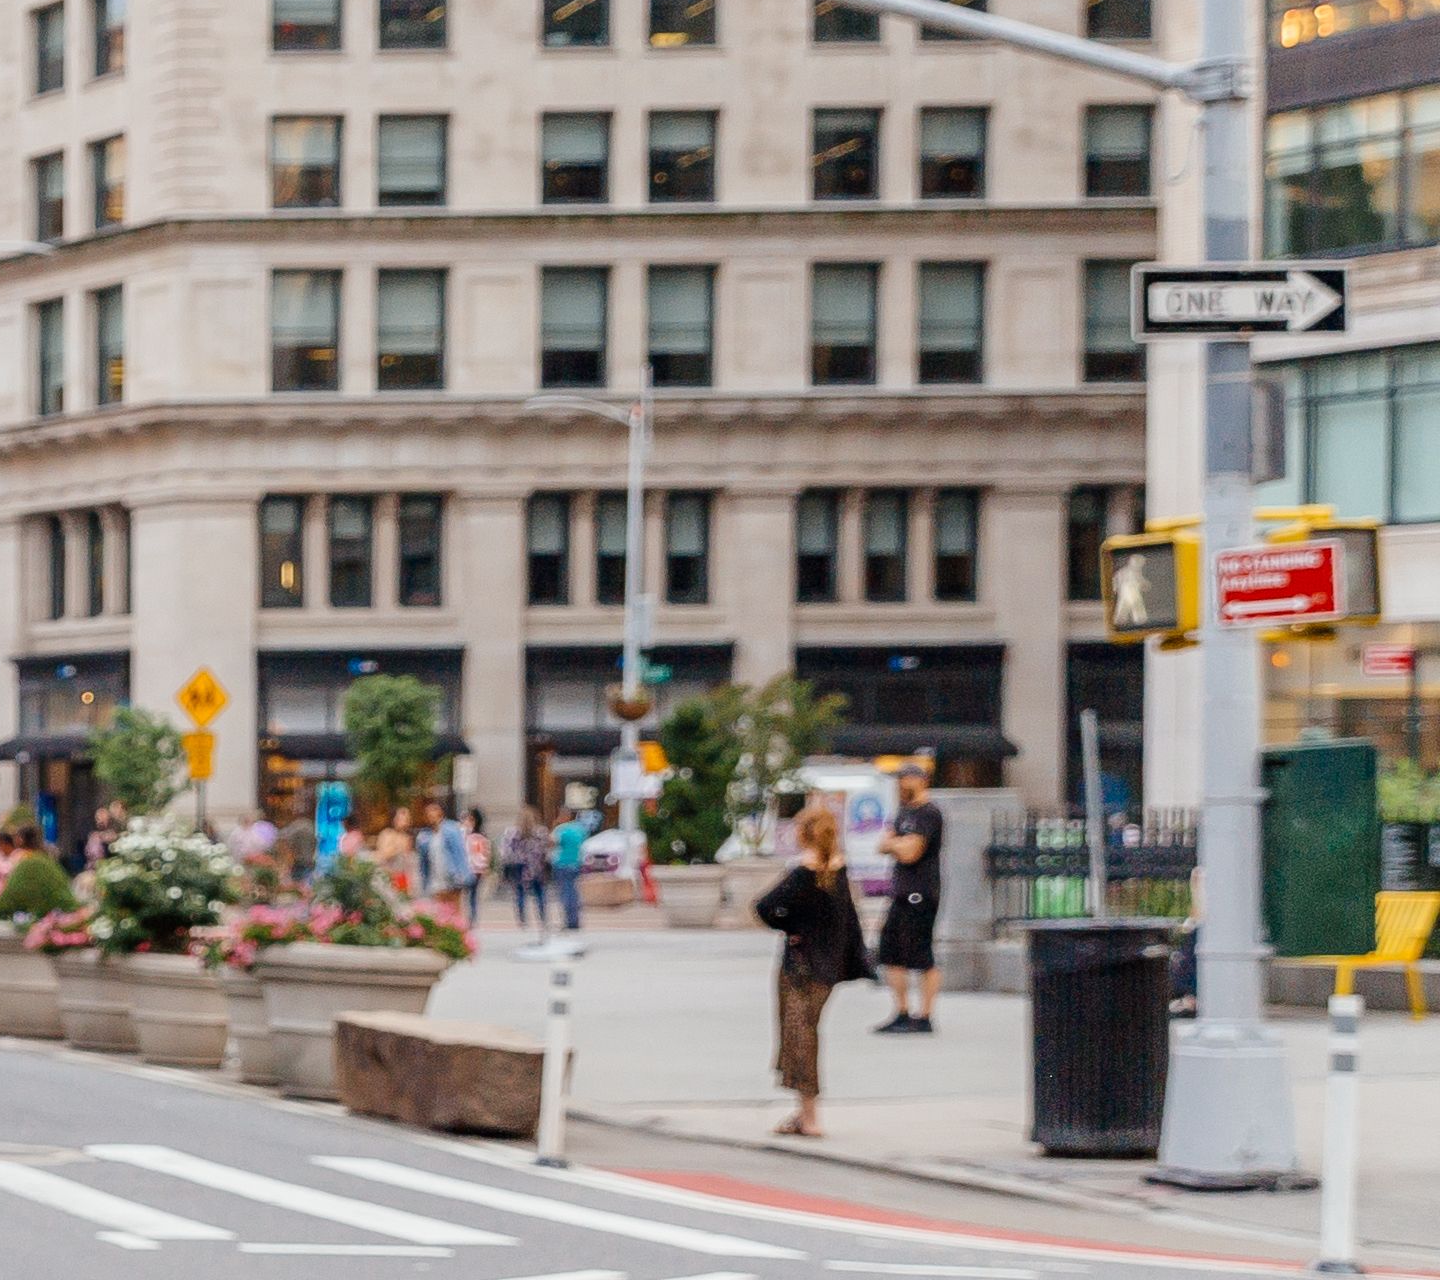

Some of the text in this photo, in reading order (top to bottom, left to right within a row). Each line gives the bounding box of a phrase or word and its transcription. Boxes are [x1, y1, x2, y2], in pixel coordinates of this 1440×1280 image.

[1166, 288, 1315, 319] ONE WAY
[1243, 551, 1323, 572] STANDING
